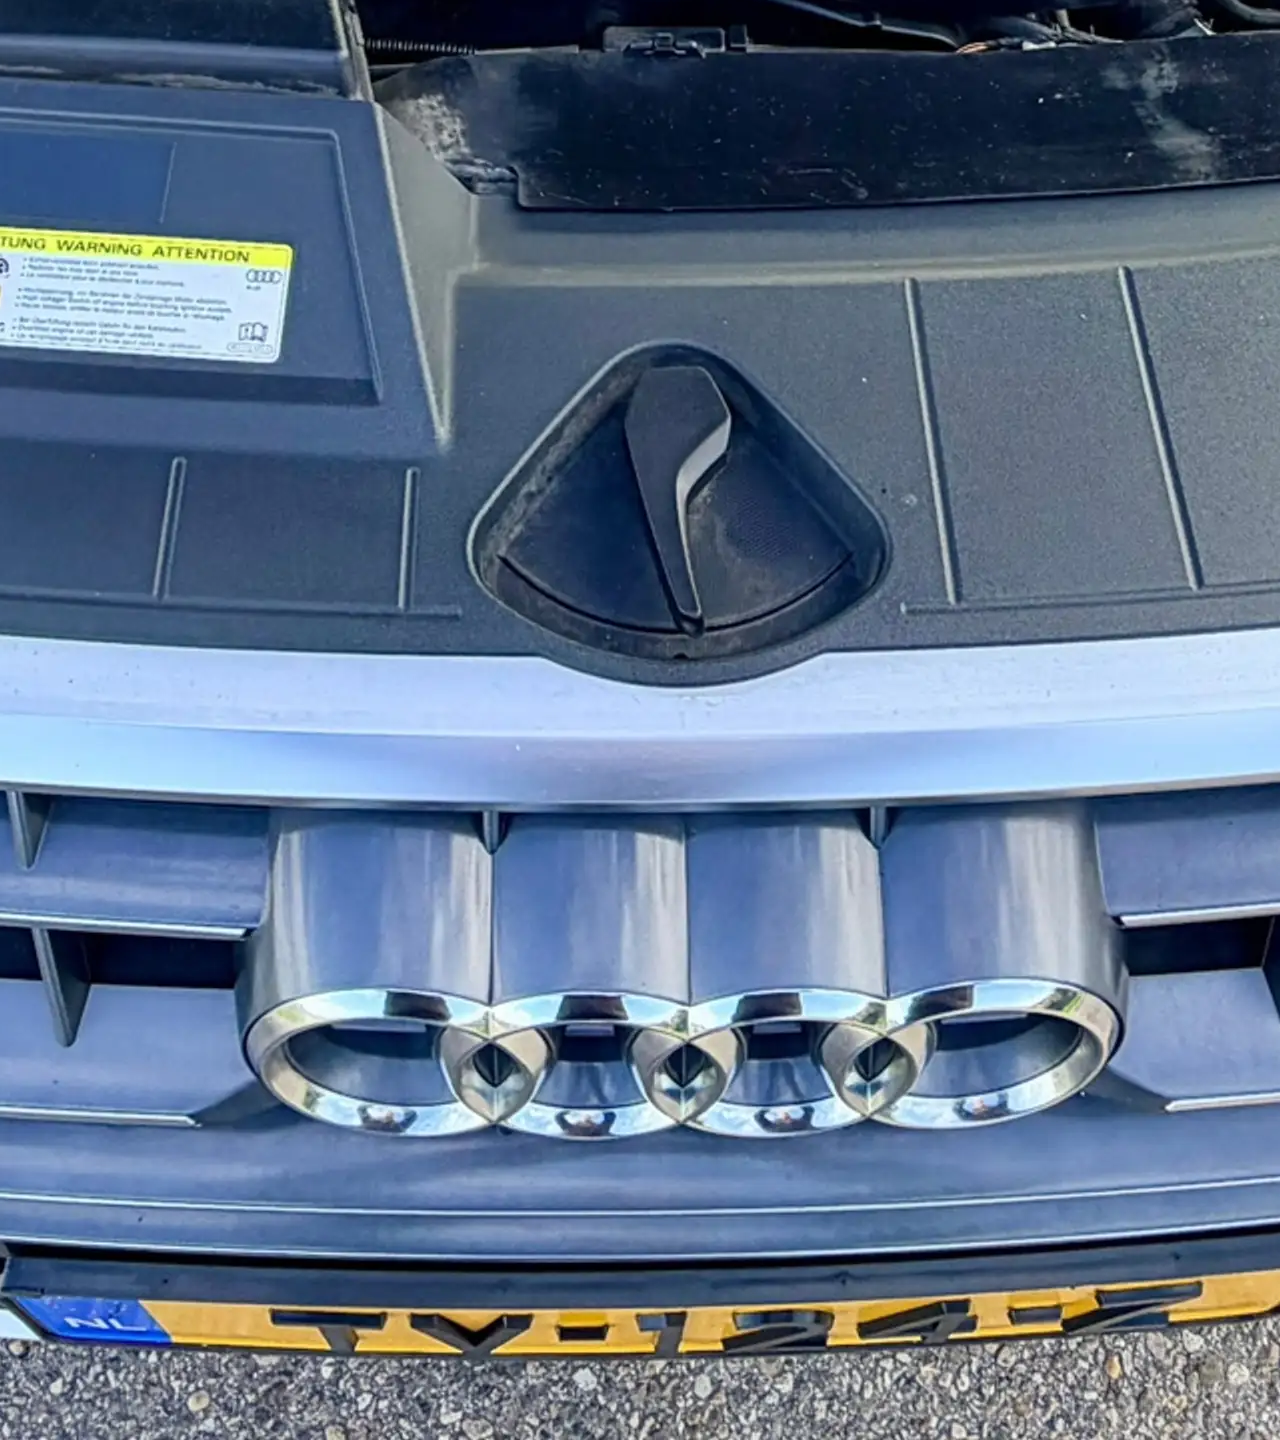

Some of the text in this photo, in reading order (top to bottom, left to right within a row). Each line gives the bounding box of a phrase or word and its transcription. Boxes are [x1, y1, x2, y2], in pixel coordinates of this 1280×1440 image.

[56, 240, 144, 258] WARNING
[152, 246, 251, 264] ATTENTION
[63, 1316, 147, 1332] NL
